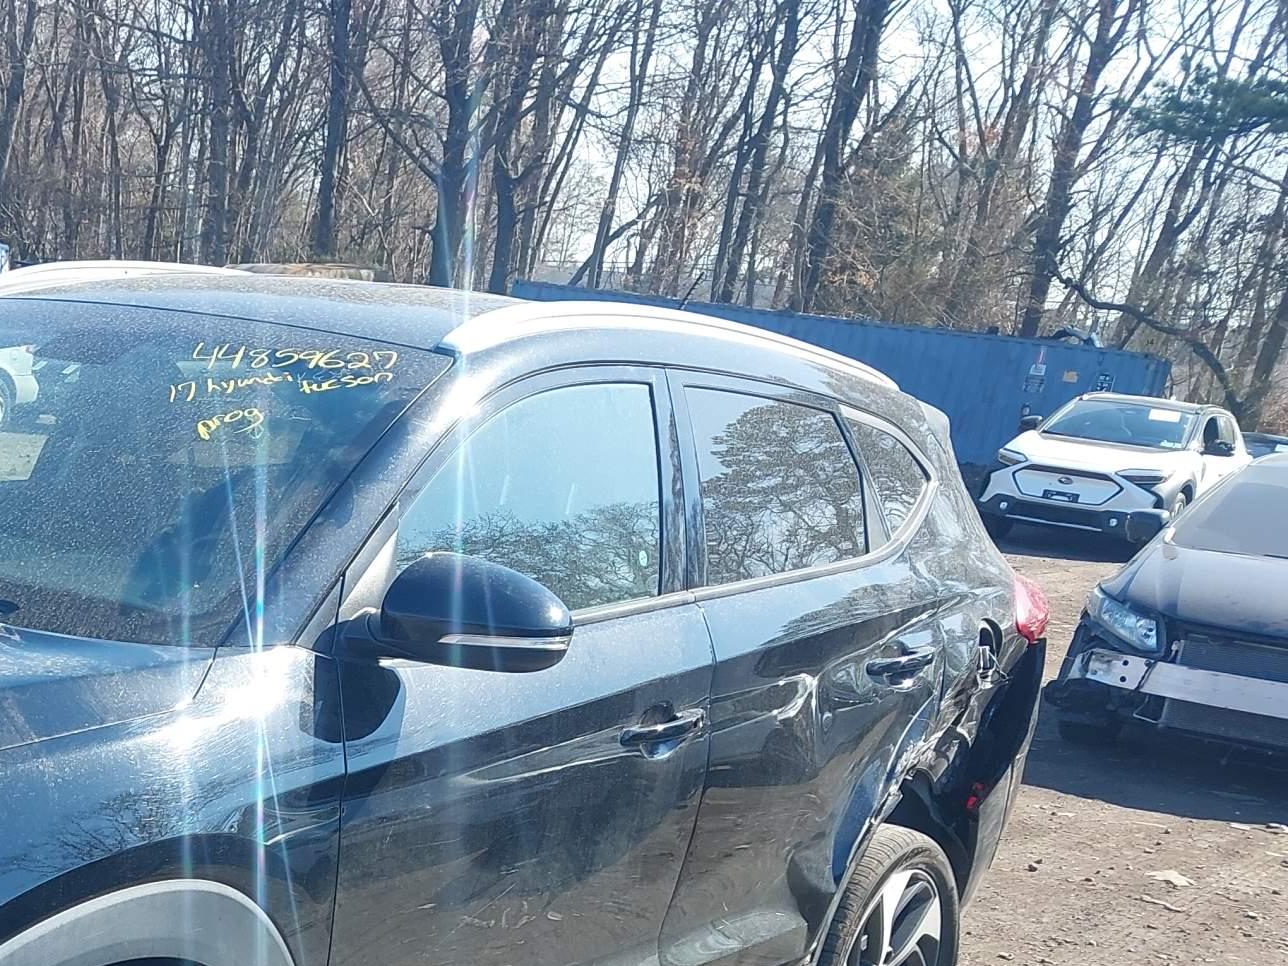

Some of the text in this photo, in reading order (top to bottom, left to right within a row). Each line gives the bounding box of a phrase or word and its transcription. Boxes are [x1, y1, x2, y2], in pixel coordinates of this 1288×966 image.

[193, 342, 398, 369] 44859627
[168, 382, 196, 402] 17
[300, 372, 393, 394] tucson
